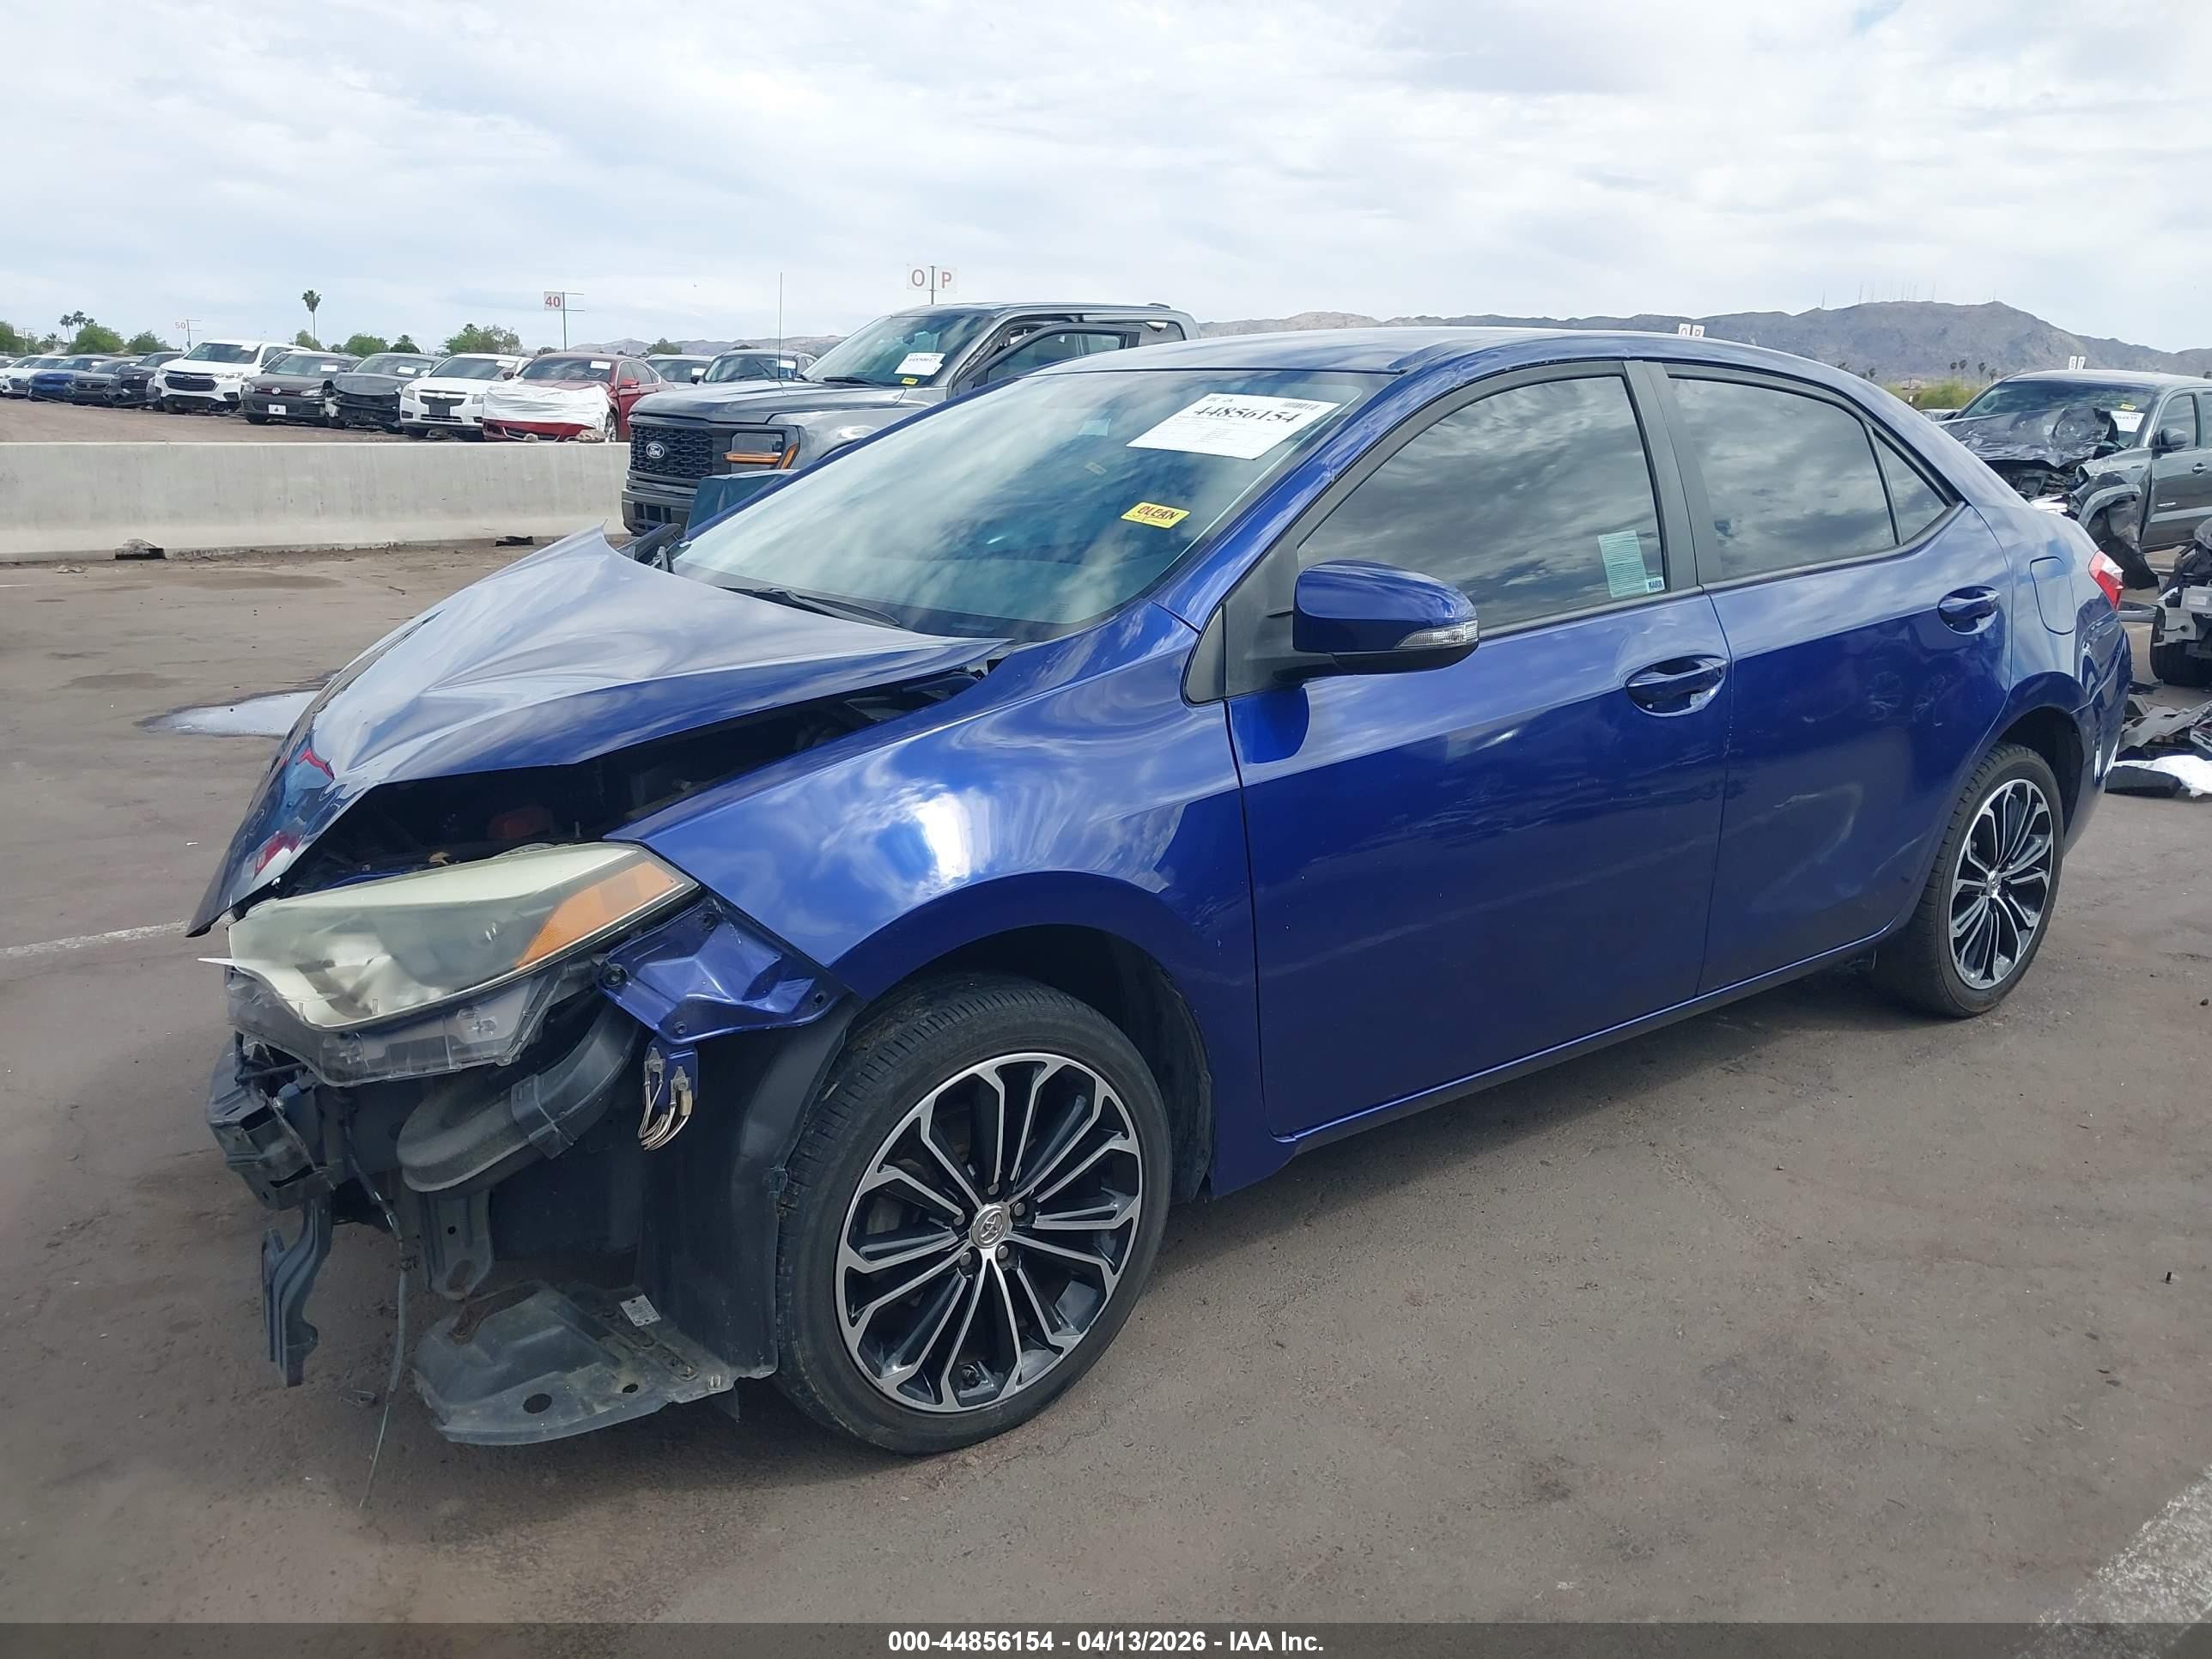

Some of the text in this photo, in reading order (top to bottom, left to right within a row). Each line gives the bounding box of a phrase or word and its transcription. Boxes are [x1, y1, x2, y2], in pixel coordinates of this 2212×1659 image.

[911, 269, 952, 289] O P
[545, 295, 561, 308] 40
[1194, 404, 1303, 423] 44856154
[1137, 505, 1180, 520] CLEAN
